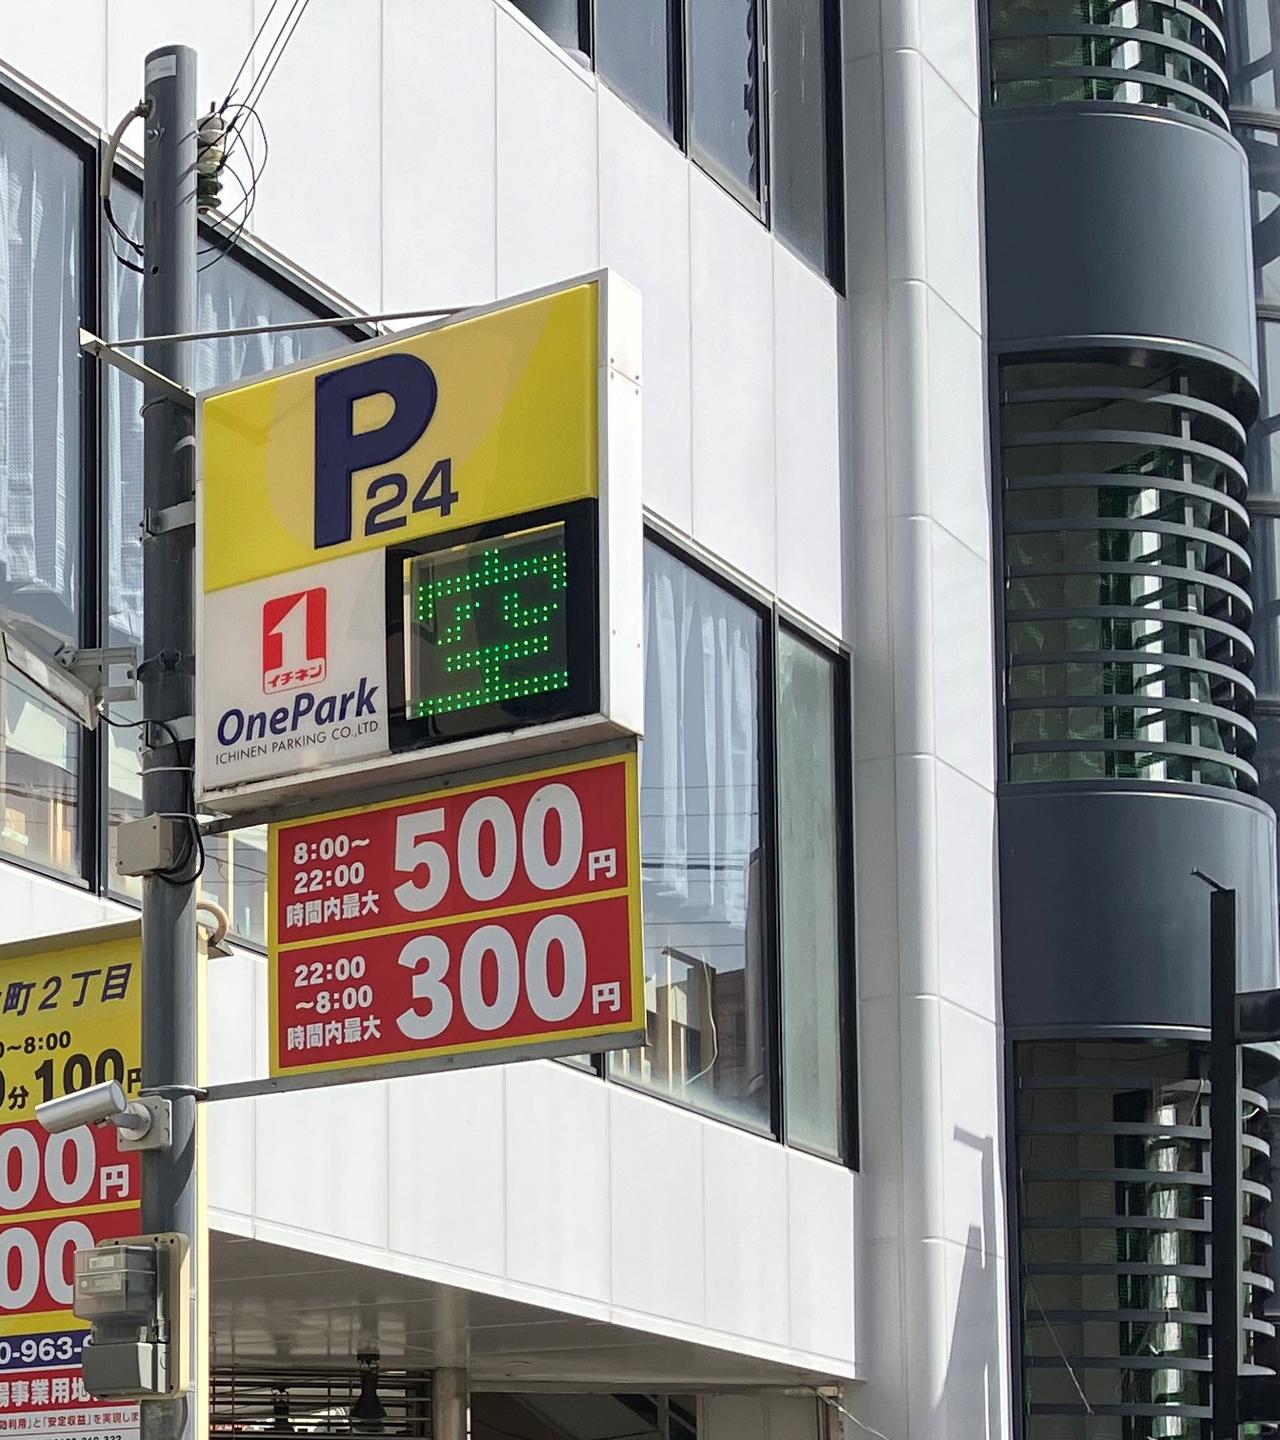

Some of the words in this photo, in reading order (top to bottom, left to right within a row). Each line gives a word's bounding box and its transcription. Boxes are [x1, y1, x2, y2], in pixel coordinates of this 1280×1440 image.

[313, 353, 438, 550] P
[364, 457, 460, 538] 24
[266, 664, 325, 689] イチネン
[216, 677, 379, 748] OnePark
[215, 743, 268, 766] ICHINEN
[271, 731, 327, 755] PARKING
[293, 861, 365, 896] 22:00
[286, 890, 380, 929] 時間内最大
[294, 955, 366, 989] 22:00
[287, 1014, 381, 1051] 時間内最大
